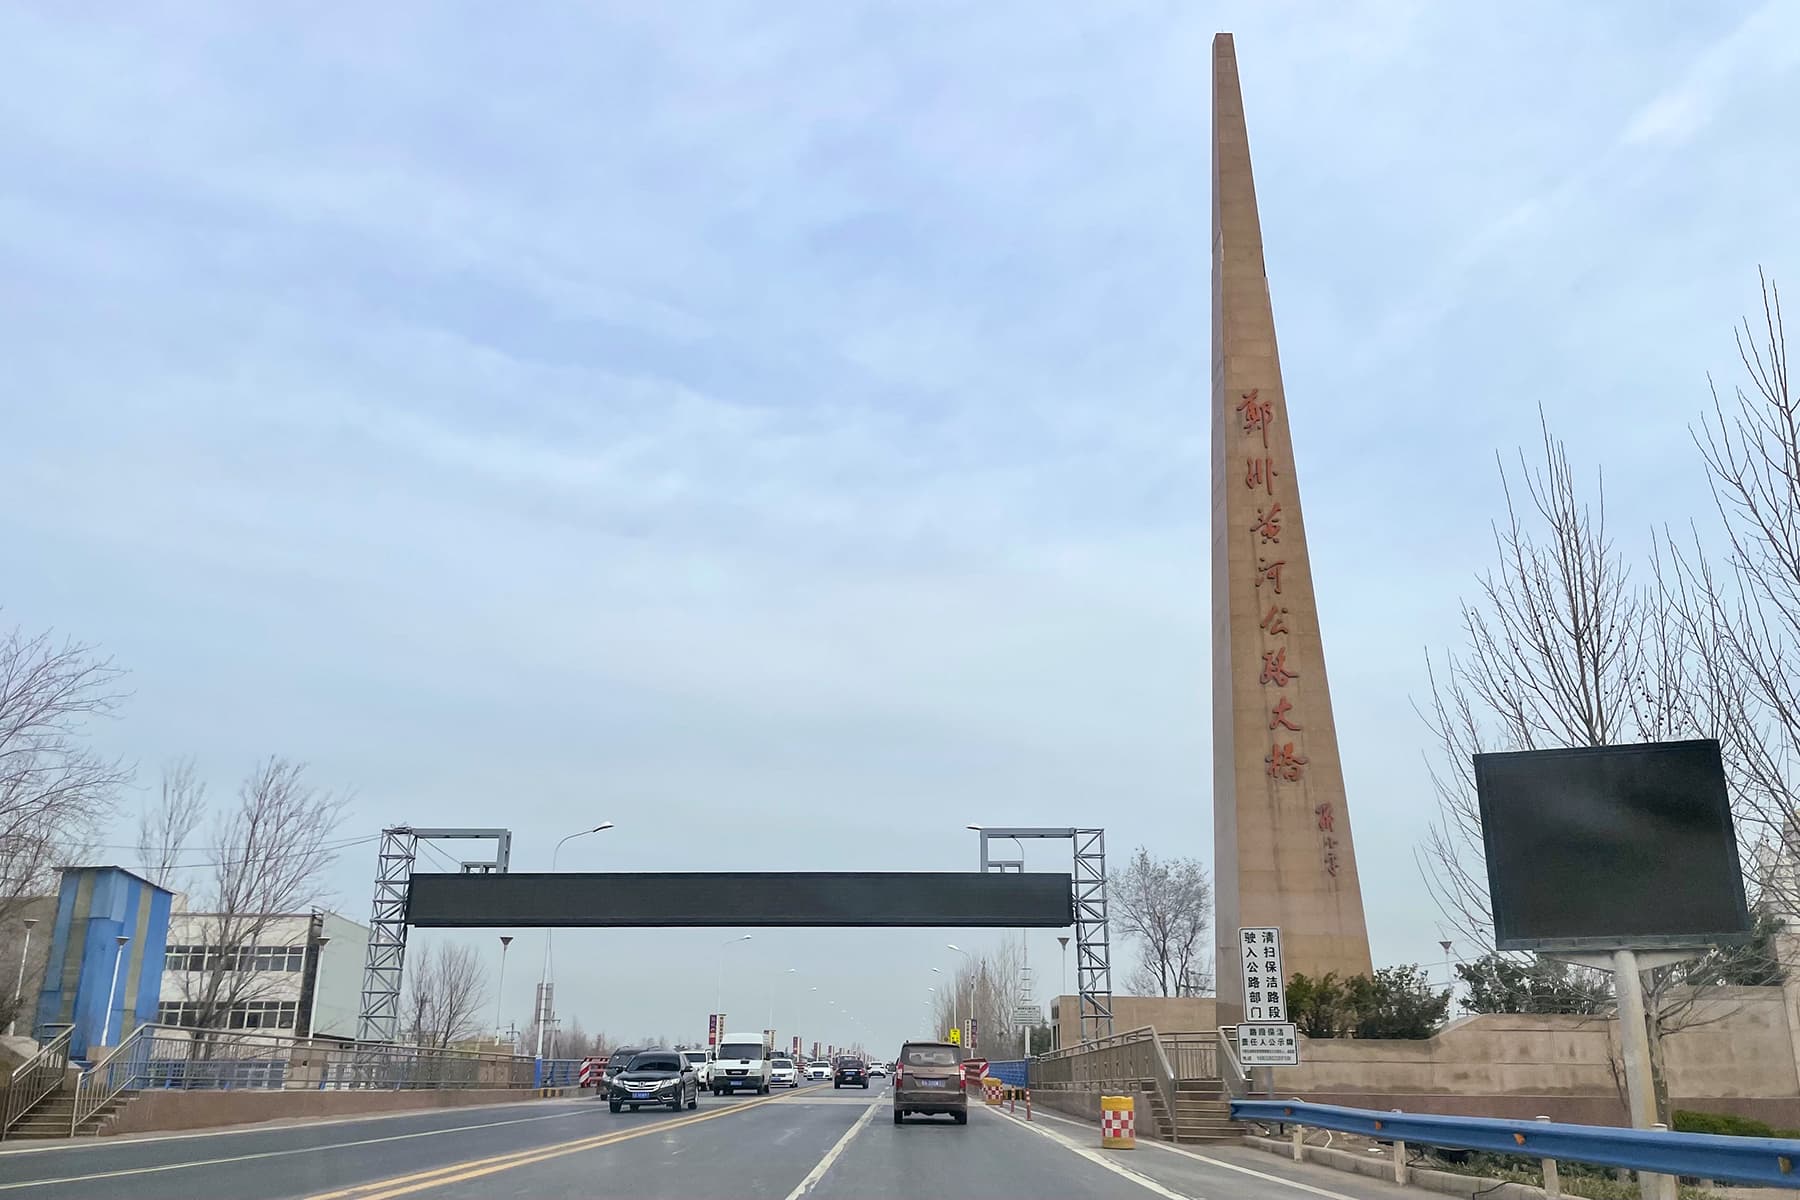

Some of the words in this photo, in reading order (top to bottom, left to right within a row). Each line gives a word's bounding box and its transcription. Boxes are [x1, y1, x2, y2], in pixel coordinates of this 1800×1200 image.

[1244, 932, 1262, 1018] 驶入公路部门
[1261, 931, 1281, 1018] 清扫保洁路段
